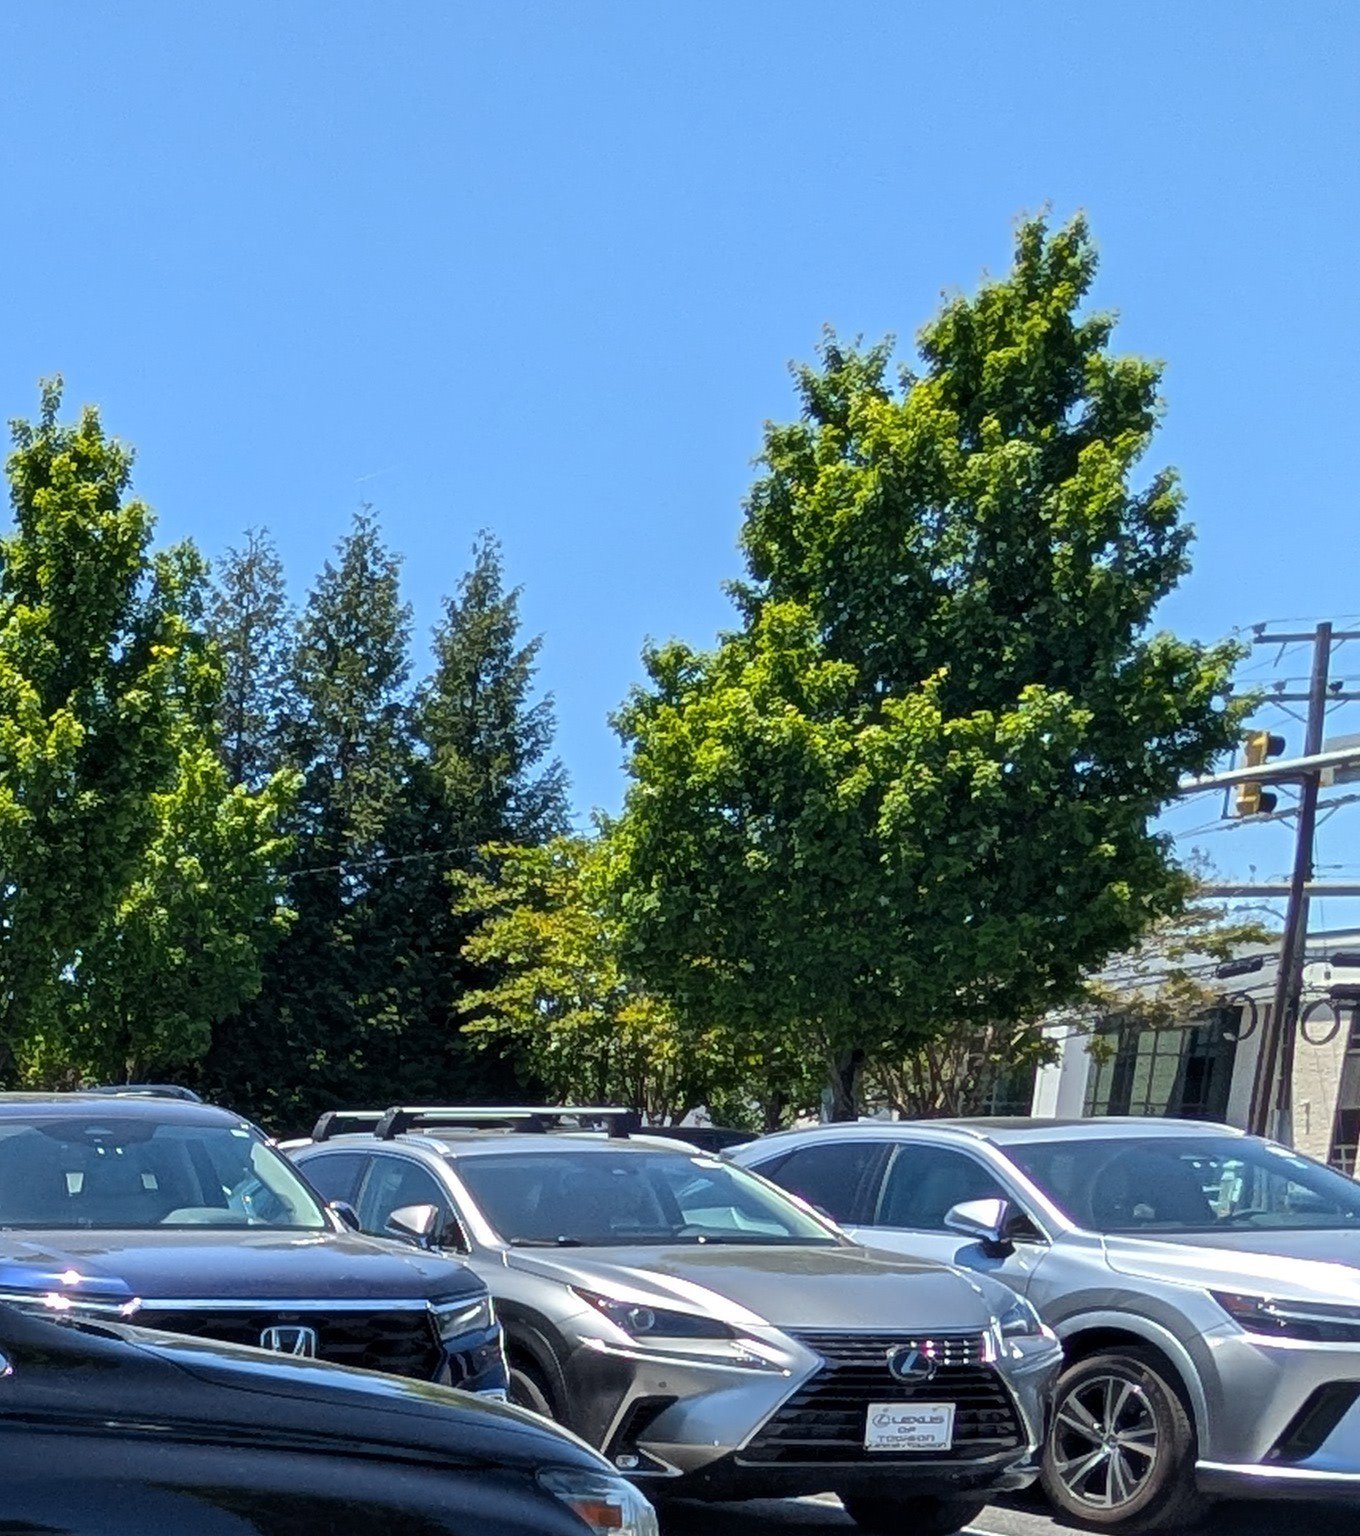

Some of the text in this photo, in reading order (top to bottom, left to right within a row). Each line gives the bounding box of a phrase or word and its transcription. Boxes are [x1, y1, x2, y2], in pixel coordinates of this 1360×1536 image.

[891, 1415, 945, 1425] LEXUS
[897, 1426, 916, 1434] OF
[876, 1434, 936, 1443] TOWSON
